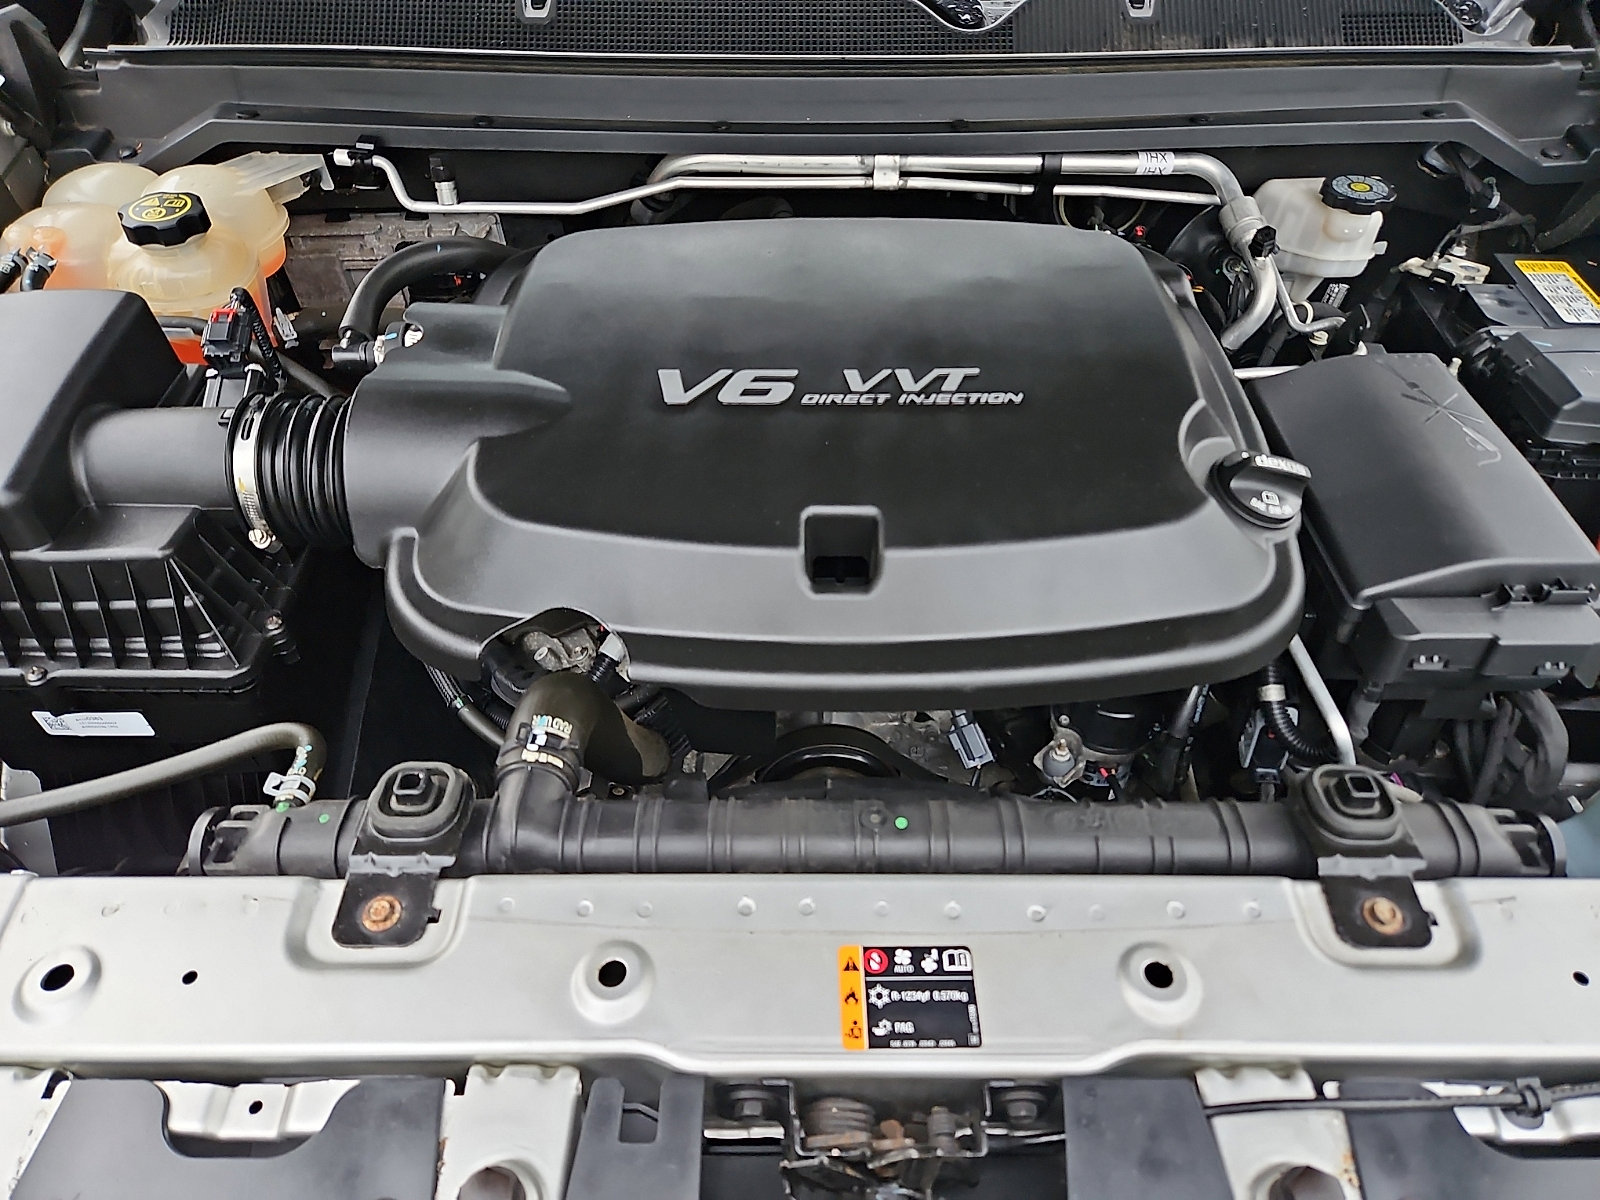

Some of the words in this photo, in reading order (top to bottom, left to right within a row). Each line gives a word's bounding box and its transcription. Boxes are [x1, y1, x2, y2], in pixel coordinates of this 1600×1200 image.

[657, 368, 799, 405] V6
[843, 367, 981, 392] VVT
[801, 393, 891, 406] DIRECT
[897, 392, 1024, 406] INJECTION
